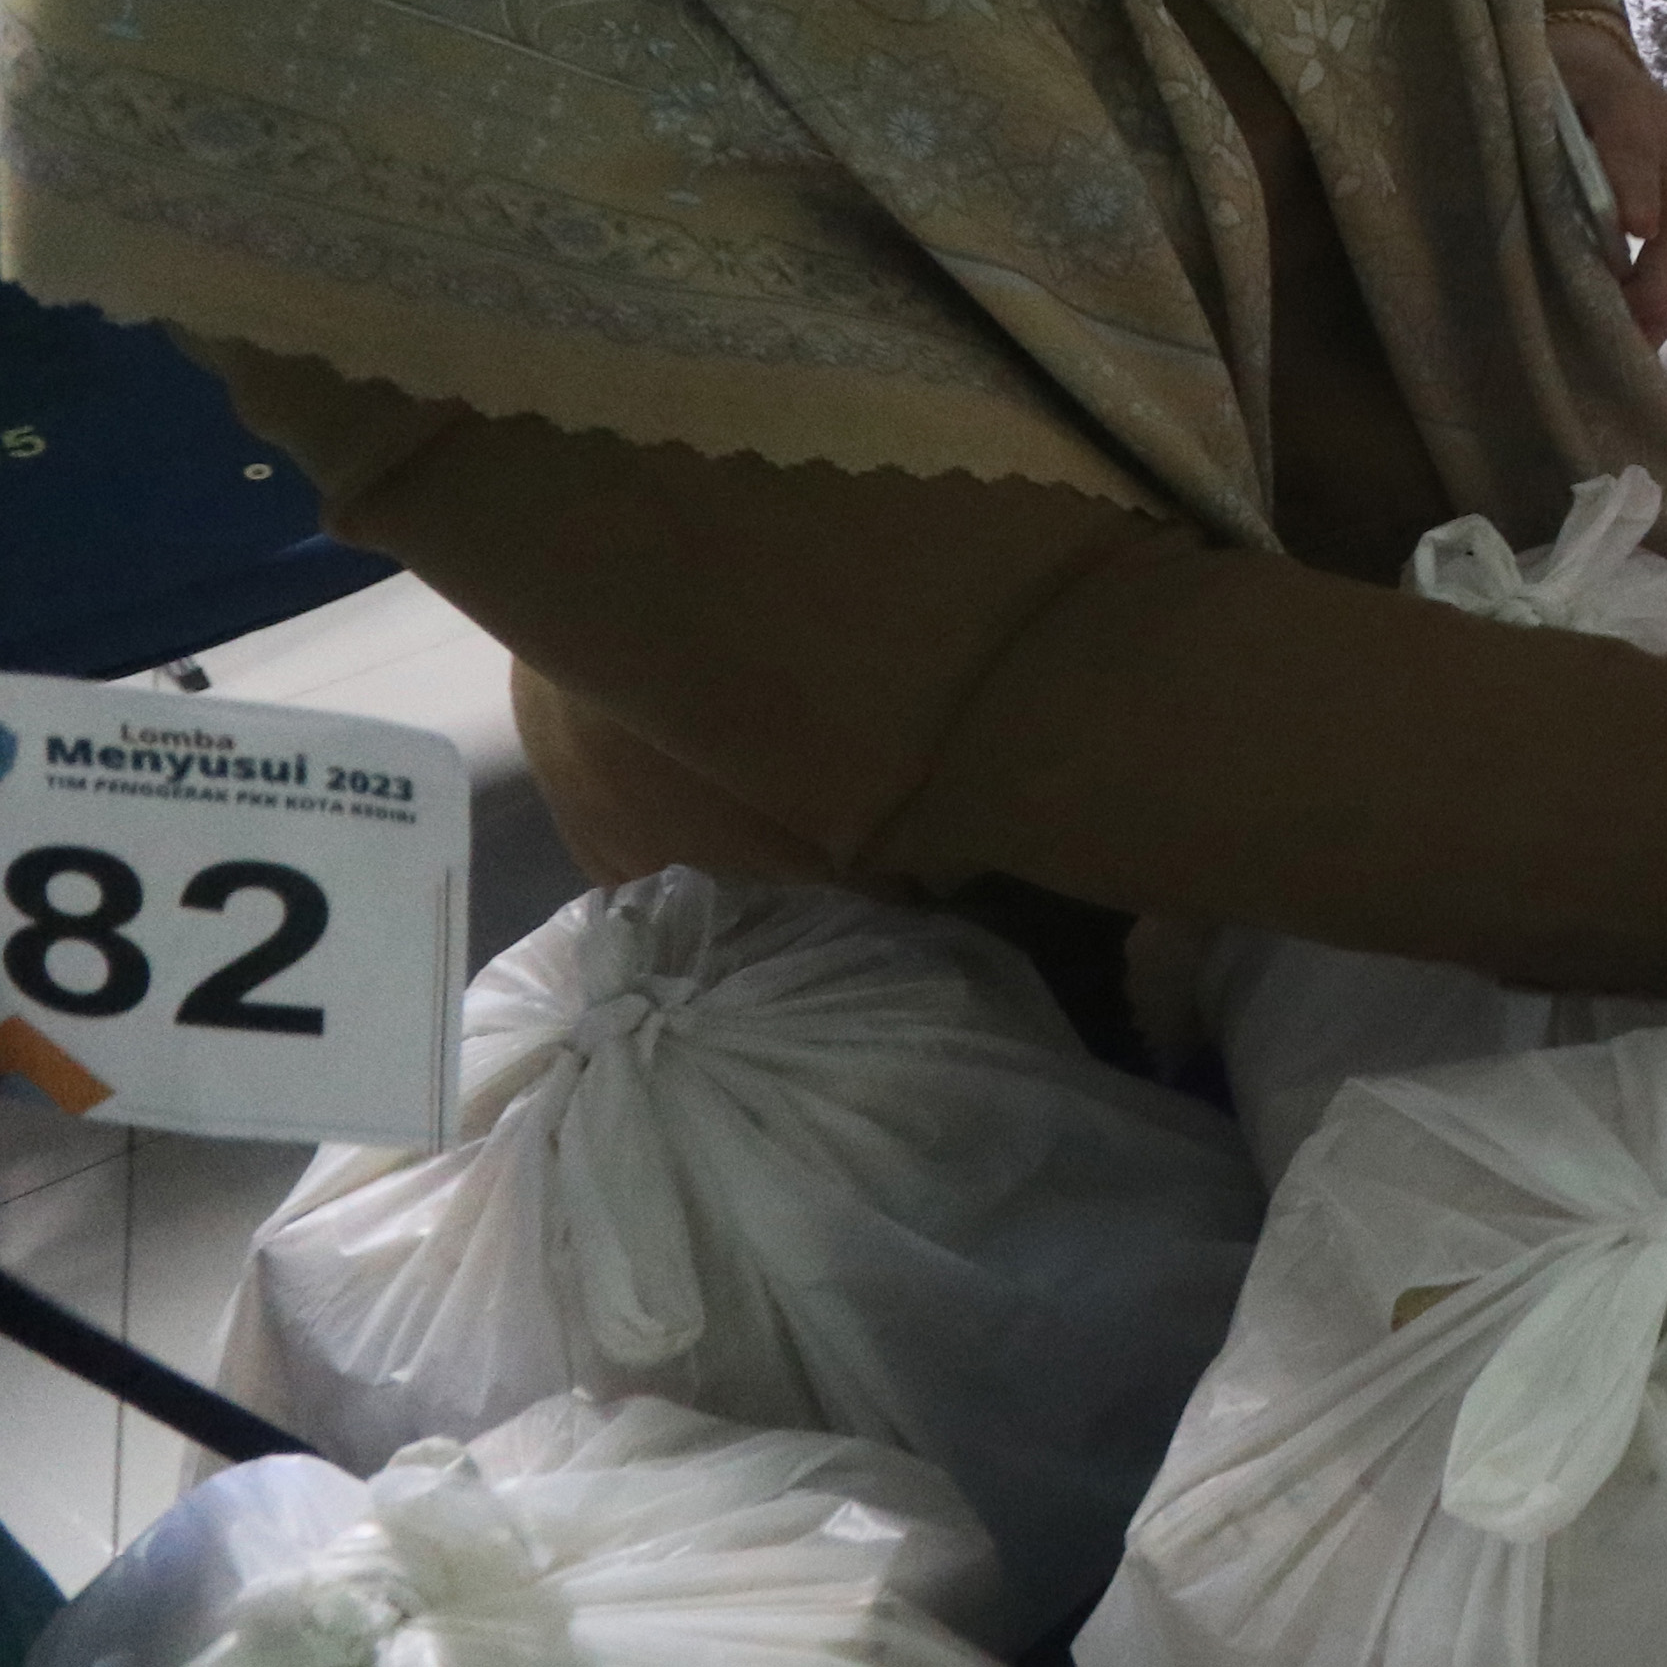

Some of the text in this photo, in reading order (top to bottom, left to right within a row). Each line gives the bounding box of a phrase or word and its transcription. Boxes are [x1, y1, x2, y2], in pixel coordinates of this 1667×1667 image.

[120, 722, 236, 751] Lomba
[45, 734, 414, 802] Menyusui 2023
[45, 774, 88, 792] TIM
[93, 777, 229, 804] PENGGERAK
[236, 789, 279, 809] PKK
[285, 794, 344, 816] KOTA
[3, 844, 330, 1037] 82
